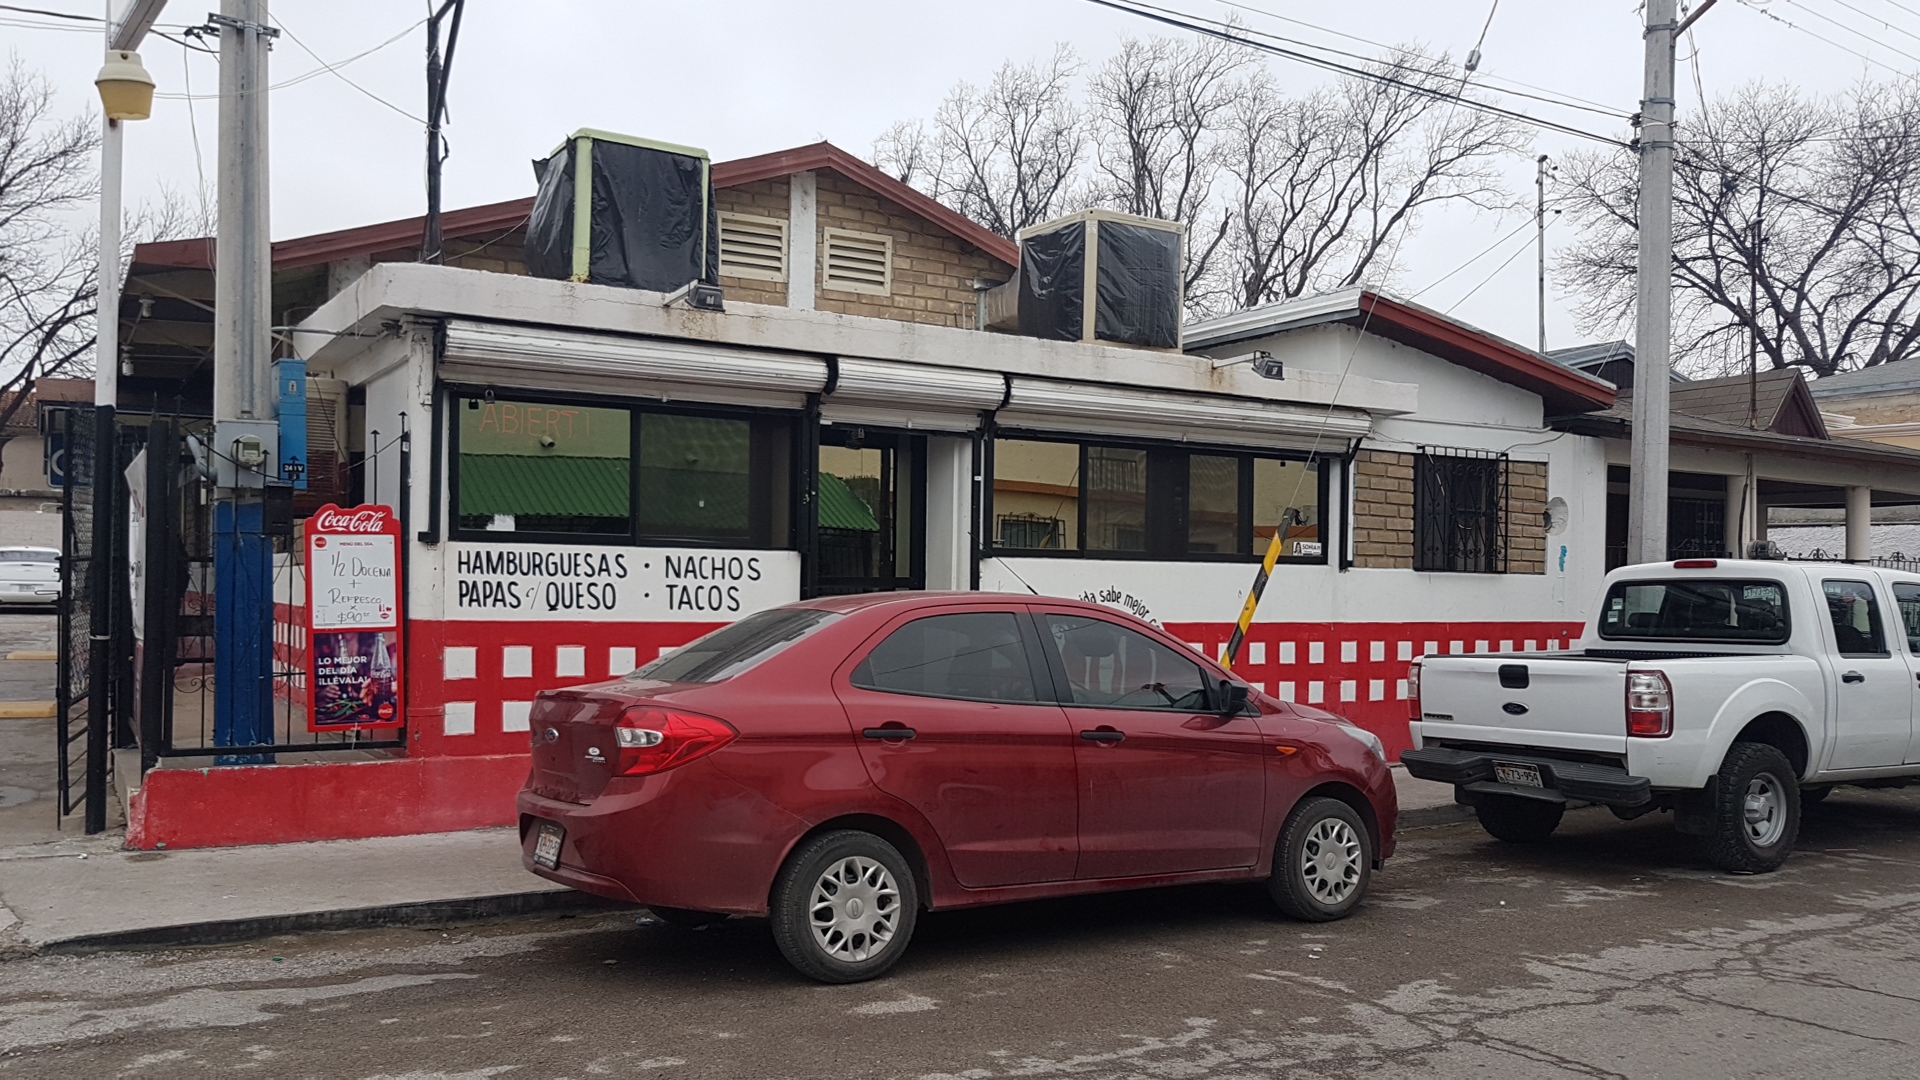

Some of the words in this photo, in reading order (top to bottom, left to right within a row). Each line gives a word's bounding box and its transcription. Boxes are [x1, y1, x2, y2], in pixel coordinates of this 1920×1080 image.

[479, 403, 590, 438] ABIERT
[317, 510, 387, 532] Coca-Cola
[458, 550, 628, 579] HAMBURGUESAS
[665, 555, 761, 581] NACHOS
[458, 580, 522, 609] PAPAS
[546, 581, 617, 611] QUESO
[665, 584, 740, 612] TACOS
[1099, 585, 1122, 603] sabe
[1123, 594, 1150, 618] mejor
[318, 657, 332, 665] LO
[334, 656, 367, 664] MEJOR
[318, 667, 337, 675] DEL
[340, 666, 357, 674] DÍA
